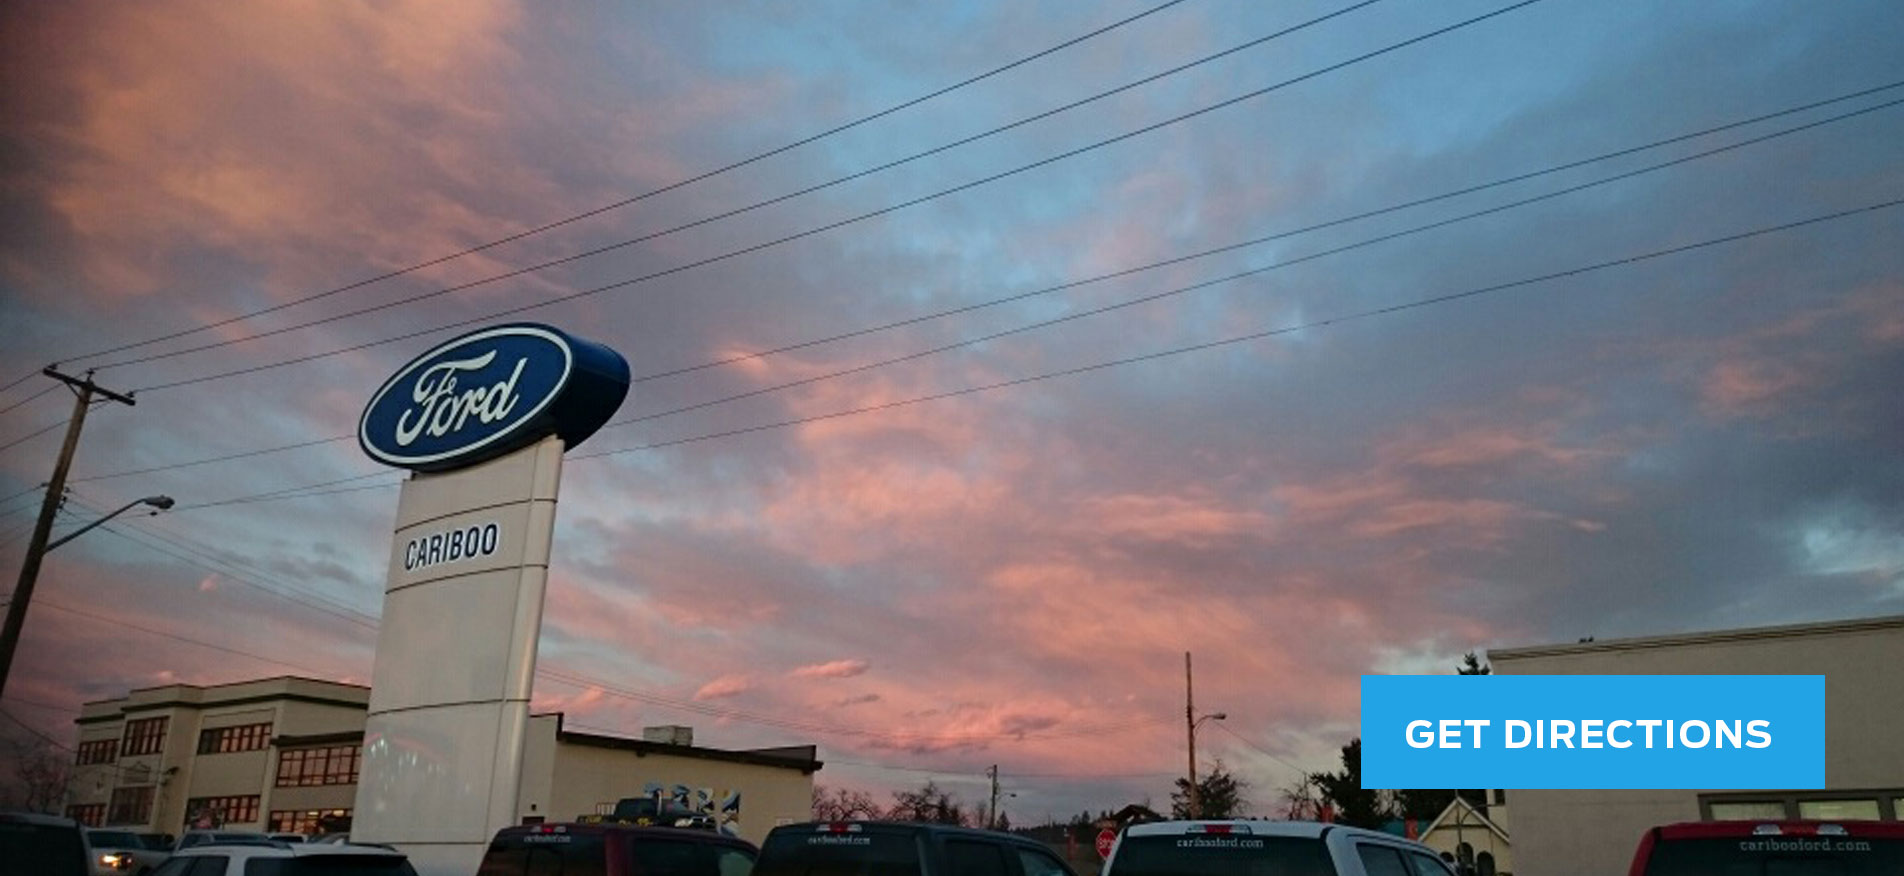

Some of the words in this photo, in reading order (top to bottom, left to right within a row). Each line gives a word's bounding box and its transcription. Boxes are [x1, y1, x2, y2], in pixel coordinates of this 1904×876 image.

[396, 349, 528, 446] Ford
[405, 523, 499, 571] CARIBOO
[1740, 838, 1872, 851] caribooford.com
